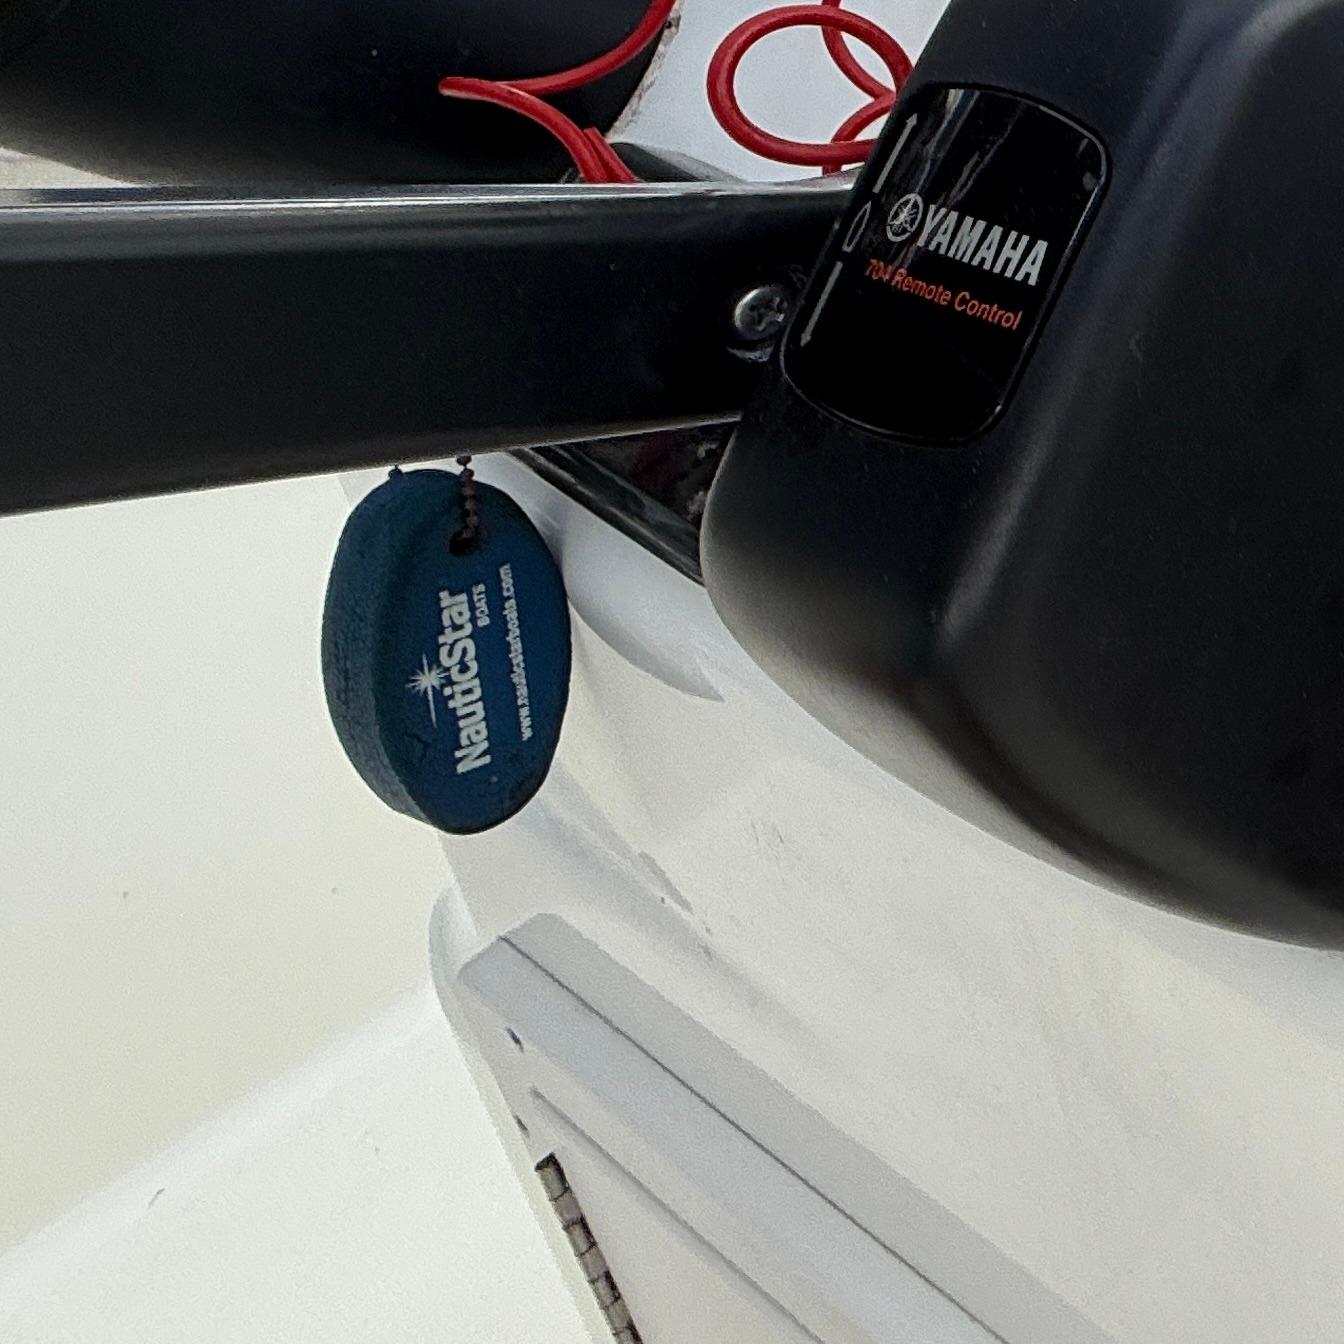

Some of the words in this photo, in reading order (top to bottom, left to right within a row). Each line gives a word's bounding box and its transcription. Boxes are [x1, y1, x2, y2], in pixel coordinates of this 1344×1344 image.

[918, 204, 1048, 287] YAMAHA
[865, 258, 890, 284] 704
[891, 268, 951, 306] Remote
[954, 291, 1023, 331] Control
[472, 583, 490, 627] BOATS
[438, 589, 491, 776] NauticStar
